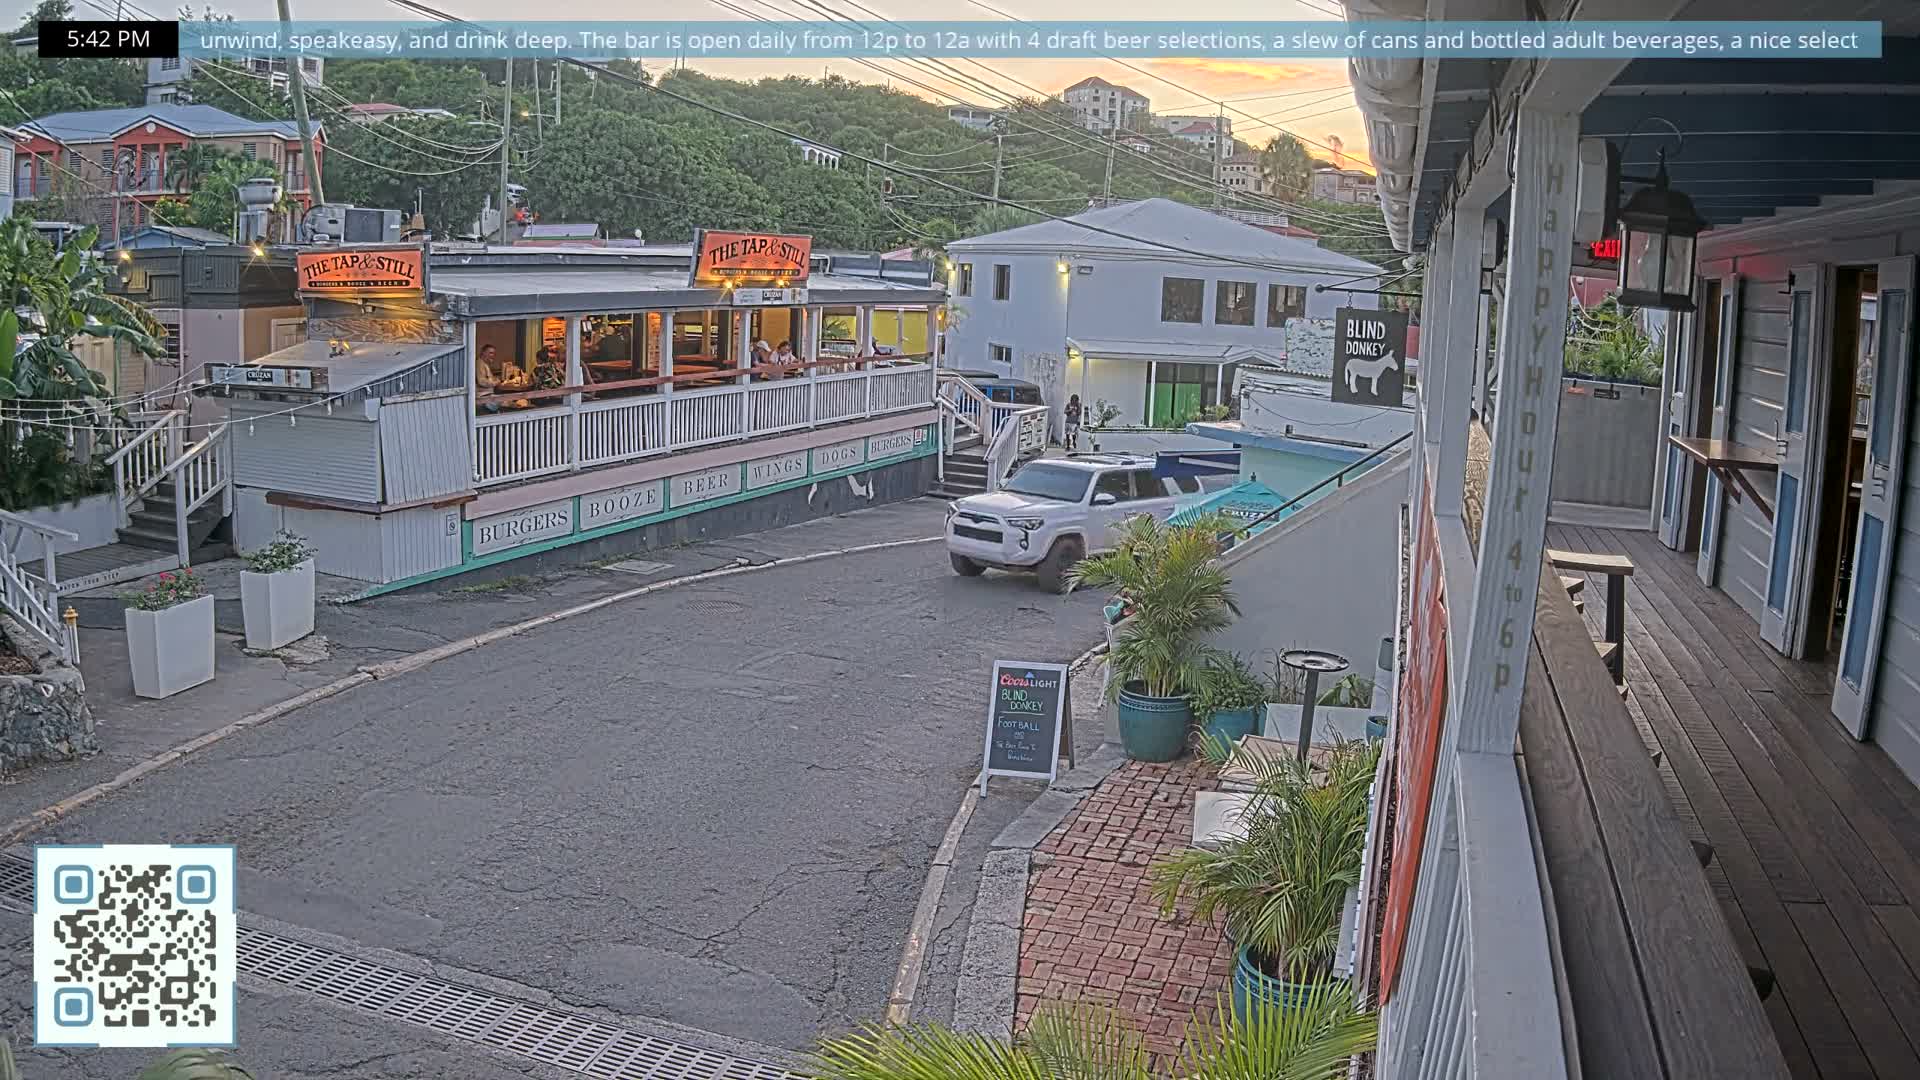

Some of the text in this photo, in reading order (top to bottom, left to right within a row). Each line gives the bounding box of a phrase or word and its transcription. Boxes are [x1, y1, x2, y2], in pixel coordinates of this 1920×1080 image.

[709, 242, 739, 265] THE
[741, 238, 767, 255] TAP
[780, 242, 805, 268] STILL
[303, 259, 331, 280] THE
[331, 255, 359, 271] TAP
[376, 256, 415, 279] STILL
[1346, 319, 1386, 340] BLIND
[1345, 341, 1386, 357] DONKEY
[247, 371, 272, 380] CRUZAN
[871, 433, 912, 455] BURGERS
[821, 446, 857, 466] DOGS
[754, 458, 803, 481] WINGS
[684, 473, 729, 496] BEER
[589, 488, 656, 518] BOOZE
[479, 510, 568, 544] BURGERS
[1508, 540, 1522, 570] 4
[1001, 688, 1028, 701] BLIND
[1030, 679, 1057, 689] LIGHT
[1010, 701, 1043, 712] DONKEY
